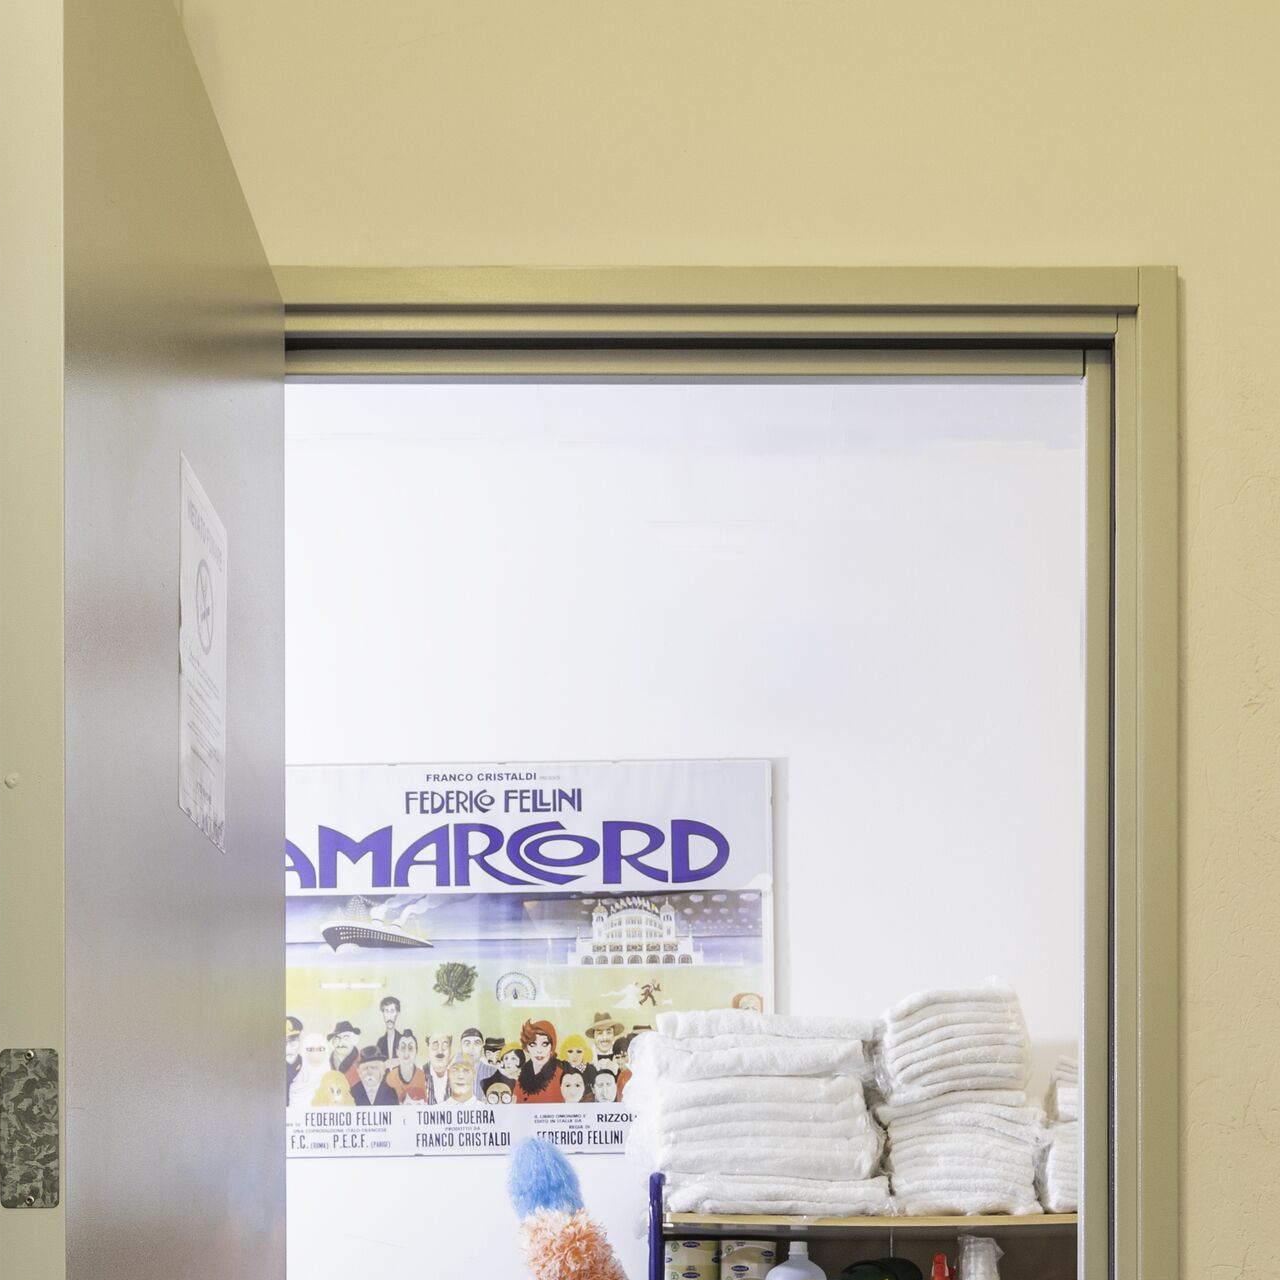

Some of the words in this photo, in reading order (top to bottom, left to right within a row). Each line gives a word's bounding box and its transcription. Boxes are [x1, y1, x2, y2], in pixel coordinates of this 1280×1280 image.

[426, 773, 473, 782] FRANCO
[477, 772, 537, 781] CRISTALDI
[405, 789, 495, 815] FEDERICO
[504, 788, 582, 813] FELLINI
[305, 1112, 352, 1127] FEDERICO
[356, 1111, 392, 1126] FELLINI
[417, 1110, 452, 1125] TONINO
[457, 1109, 496, 1124] GUERRA
[597, 1113, 637, 1123] RIZZOL
[416, 1133, 454, 1148] FRANCO
[458, 1131, 511, 1147] CRISTALDI
[588, 1130, 623, 1145] FELLINI
